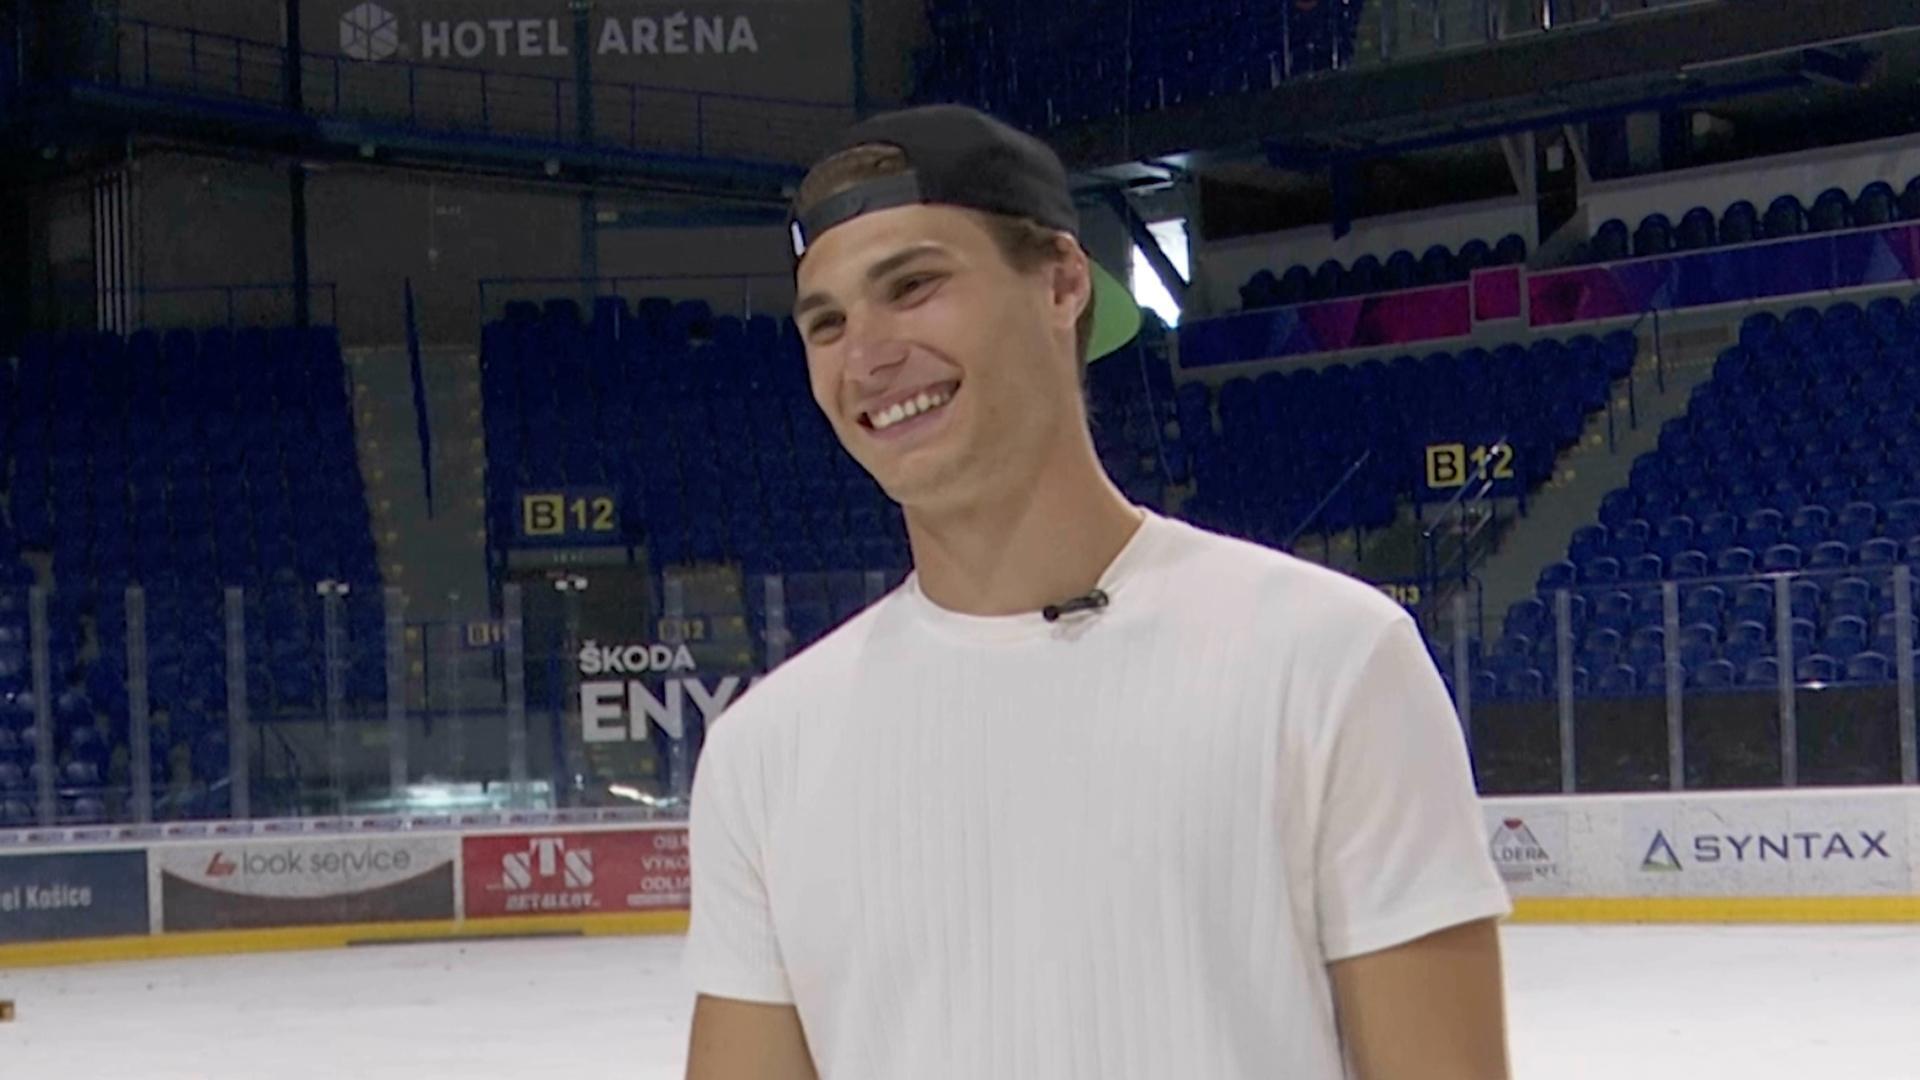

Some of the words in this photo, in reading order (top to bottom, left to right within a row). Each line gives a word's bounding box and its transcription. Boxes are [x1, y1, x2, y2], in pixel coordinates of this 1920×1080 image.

[421, 18, 569, 59] HOTEL
[597, 11, 759, 55] ARÉNA
[1432, 449, 1458, 482] B
[1470, 443, 1515, 480] 12
[530, 499, 558, 531] B
[571, 498, 615, 531] 12
[579, 640, 696, 673] ŠKODA
[580, 675, 764, 743] ENY
[242, 849, 303, 876] look
[309, 848, 411, 874] service
[502, 837, 594, 890] STS
[1694, 830, 1892, 863] SYNTAX
